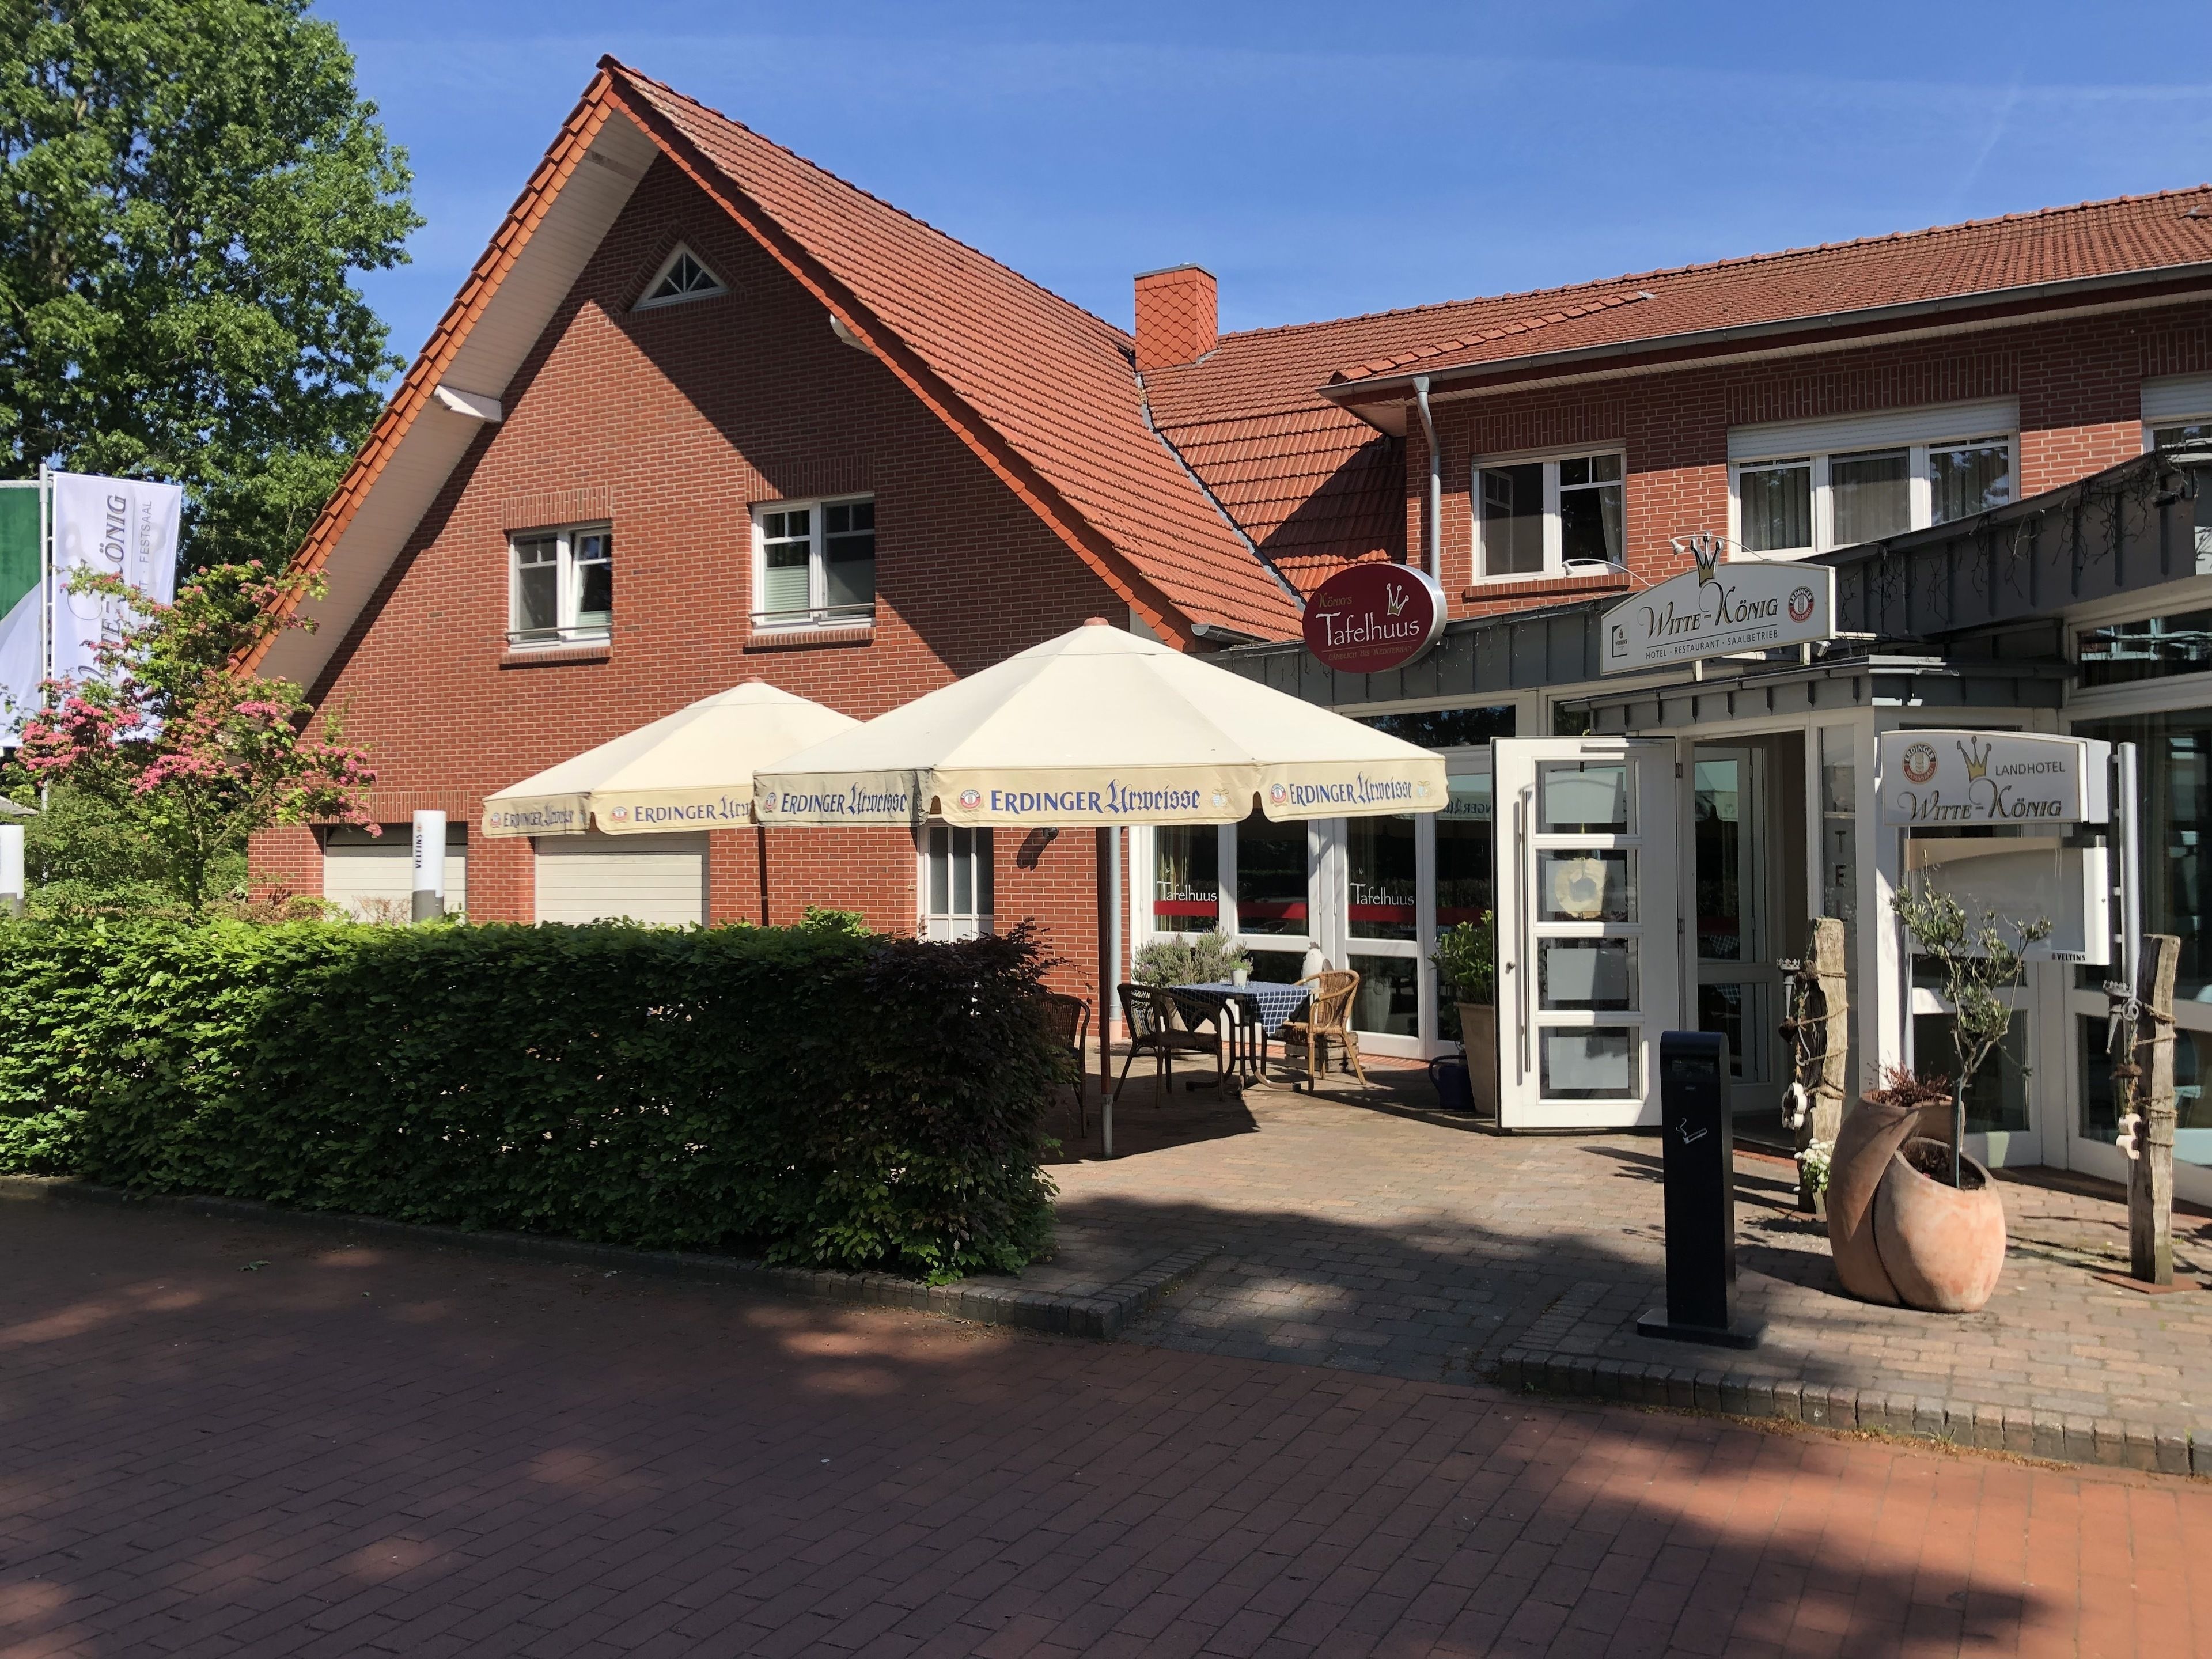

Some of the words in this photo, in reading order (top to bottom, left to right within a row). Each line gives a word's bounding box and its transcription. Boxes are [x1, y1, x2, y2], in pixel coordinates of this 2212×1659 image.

[139, 500, 153, 563] FESTSAAL
[1790, 588, 1812, 604] ERDINGER
[1316, 612, 1420, 646] Tafelhuus
[1646, 649, 1667, 660] HOTEL
[1674, 639, 1719, 655] RESTAURANT
[1728, 630, 1779, 646] SAALBETRIEB
[1905, 745, 1935, 762] ERDINGER
[1995, 761, 2066, 777] LANDHOTEL
[781, 792, 845, 815] ERDINGER
[845, 782, 907, 815] Urweisse
[991, 790, 1104, 815] ERDINGER
[1104, 778, 1200, 815] Urweisse
[1289, 783, 1356, 806] ERDINGER
[1356, 771, 1412, 804] Urweisse
[635, 805, 717, 823] ERDINGER
[415, 834, 423, 869] VELTINS
[1157, 881, 1217, 902] Tafelhuus
[1350, 882, 1415, 907] Tafelhuus
[2056, 952, 2086, 961] VELTINS
